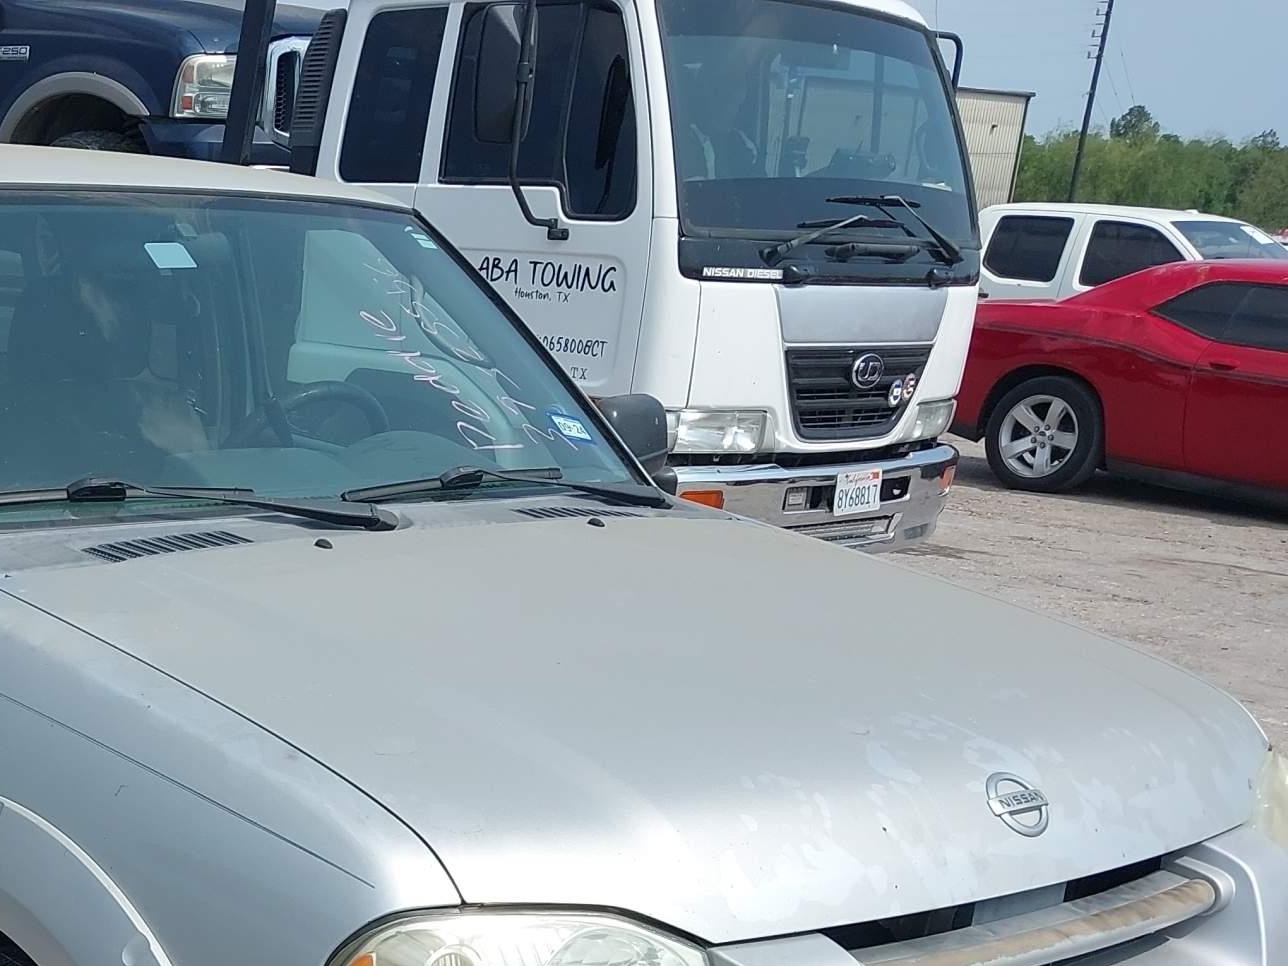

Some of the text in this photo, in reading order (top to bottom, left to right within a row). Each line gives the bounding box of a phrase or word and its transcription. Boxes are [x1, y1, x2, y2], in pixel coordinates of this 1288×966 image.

[478, 256, 617, 293] ABA TOWING
[702, 267, 784, 279] NISSAN DIESEL
[514, 287, 571, 304] Houston, TX
[570, 366, 588, 380] TX
[836, 483, 878, 509] 8Y68817
[998, 790, 1044, 809] NISSAN
